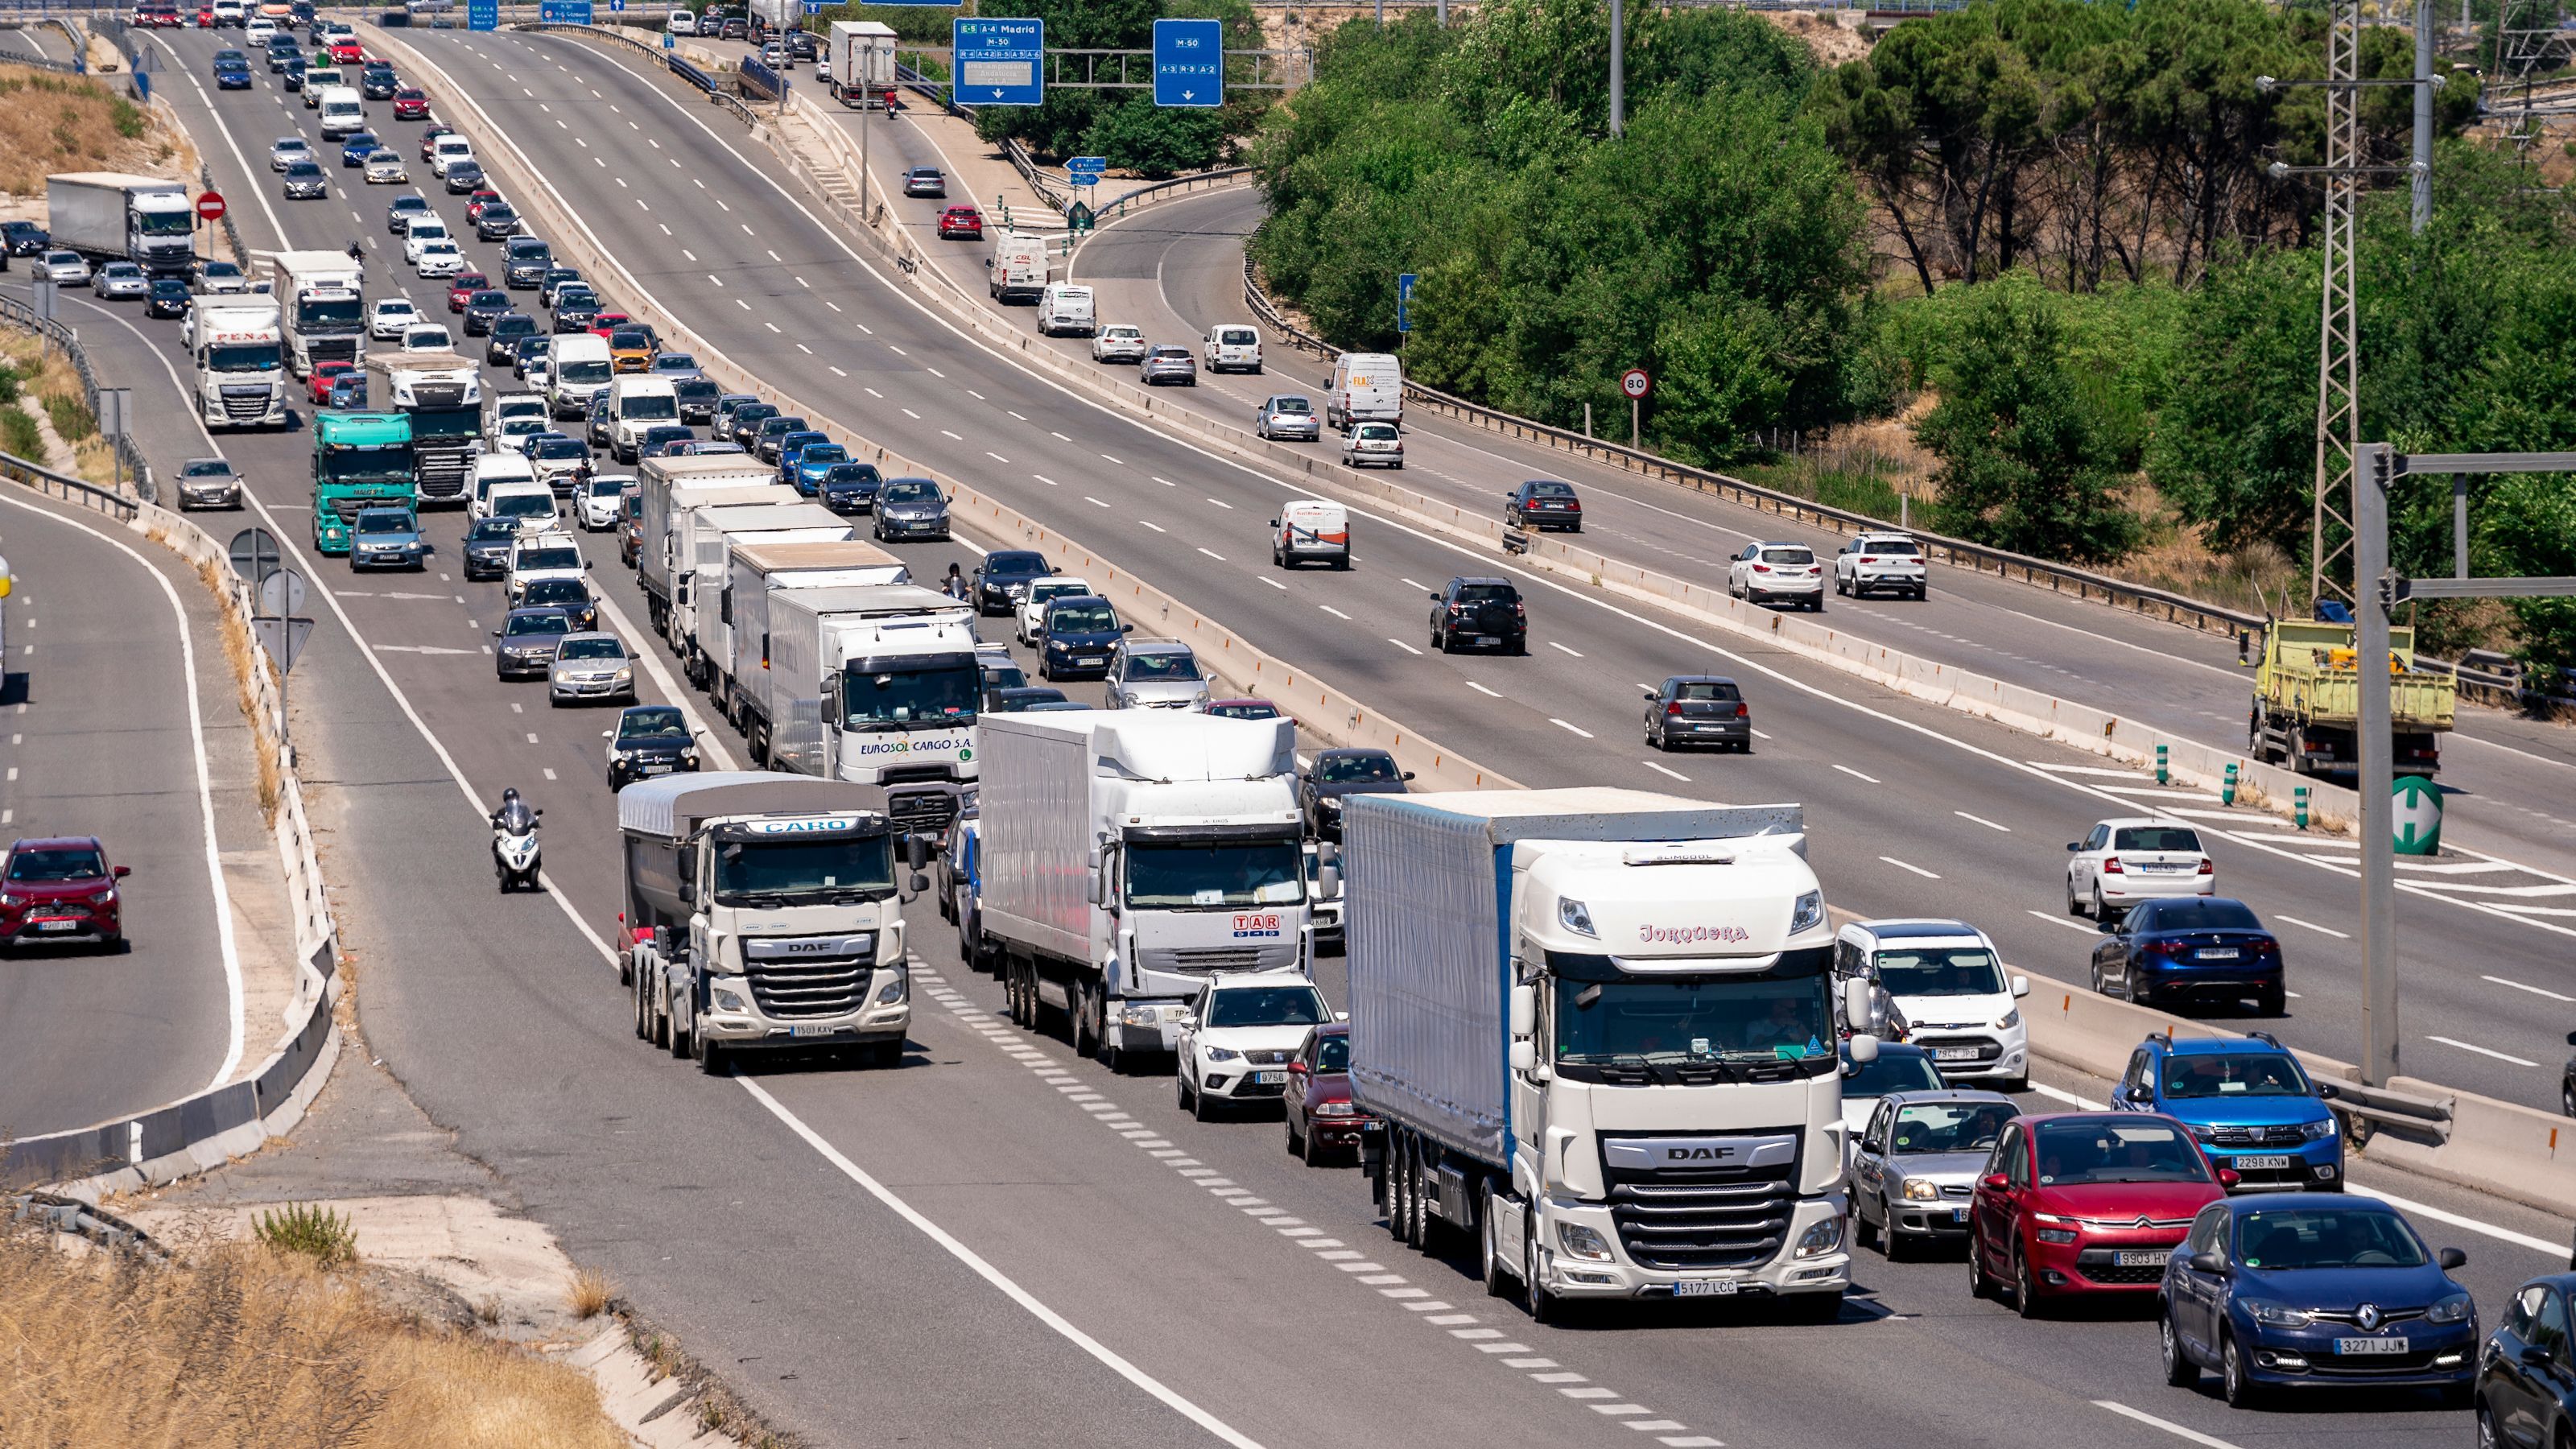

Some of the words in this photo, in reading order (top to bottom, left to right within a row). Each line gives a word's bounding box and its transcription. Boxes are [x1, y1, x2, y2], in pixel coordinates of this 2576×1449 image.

[1001, 25, 1035, 33] Madrid
[1628, 379, 1644, 388] 80
[861, 742, 909, 754] EUROSOL
[913, 740, 952, 750] CARGO
[954, 738, 974, 749] S.A.
[766, 820, 846, 832] CARO
[1236, 917, 1278, 928] TAR
[788, 943, 832, 952] DAF
[1668, 1147, 1735, 1160] DAF
[2237, 1157, 2263, 1167] 2298
[2268, 1157, 2287, 1166] KNM
[2121, 1255, 2150, 1265] 9903
[2154, 1254, 2169, 1264] HY
[1680, 1282, 1708, 1294] 5177
[1711, 1282, 1734, 1294] LCC
[2342, 1340, 2374, 1352] 3271
[2380, 1340, 2405, 1352] JJW
